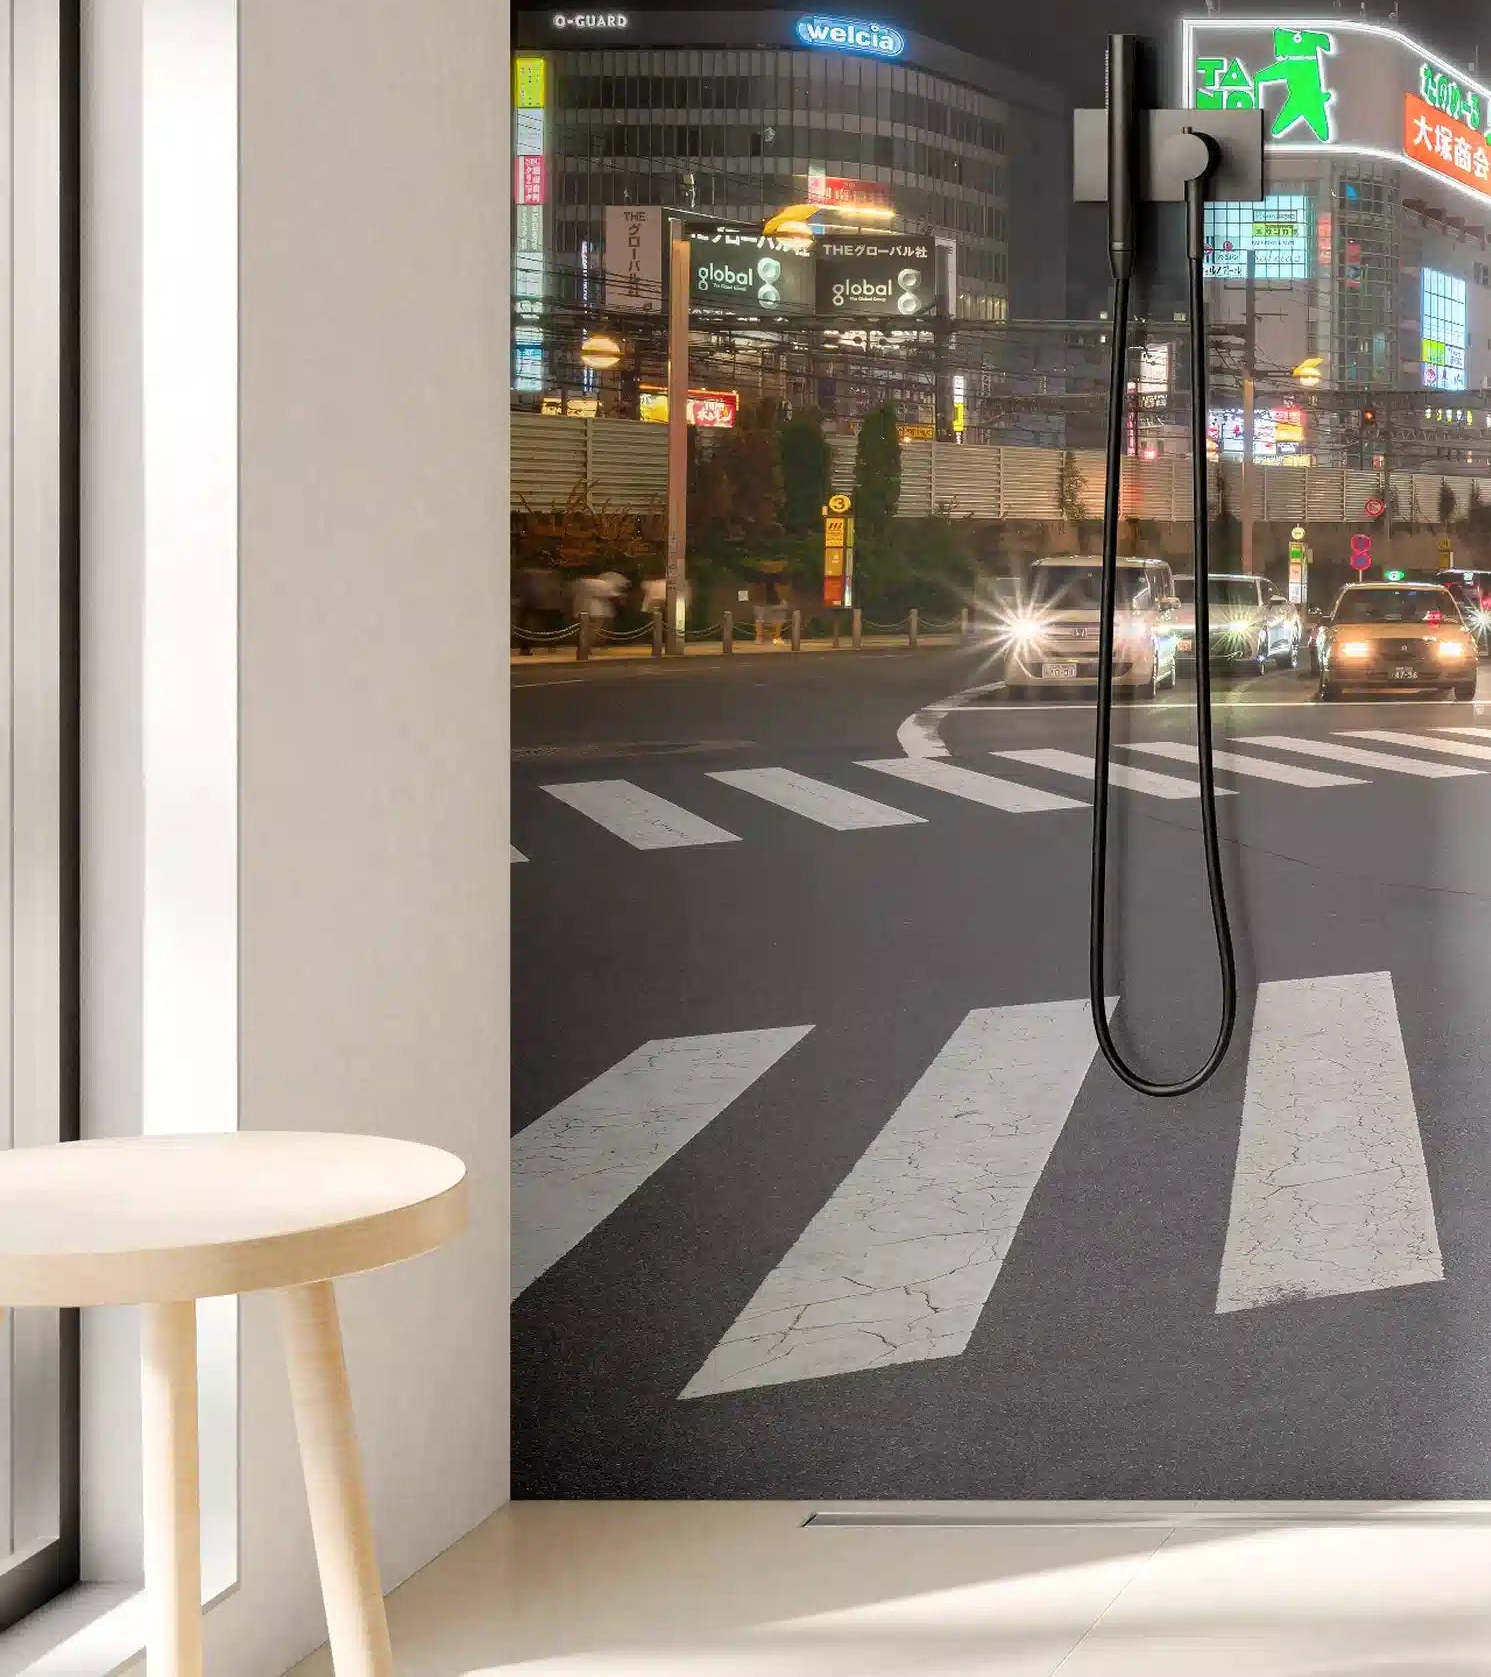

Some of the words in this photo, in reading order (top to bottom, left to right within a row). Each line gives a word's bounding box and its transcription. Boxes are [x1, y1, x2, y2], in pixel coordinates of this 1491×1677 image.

[807, 21, 895, 53] welcia
[1413, 113, 1491, 181] 大塚商会
[822, 243, 929, 258] THEグローバル社
[697, 263, 753, 291] global
[832, 280, 893, 306] global
[835, 499, 846, 510] 3
